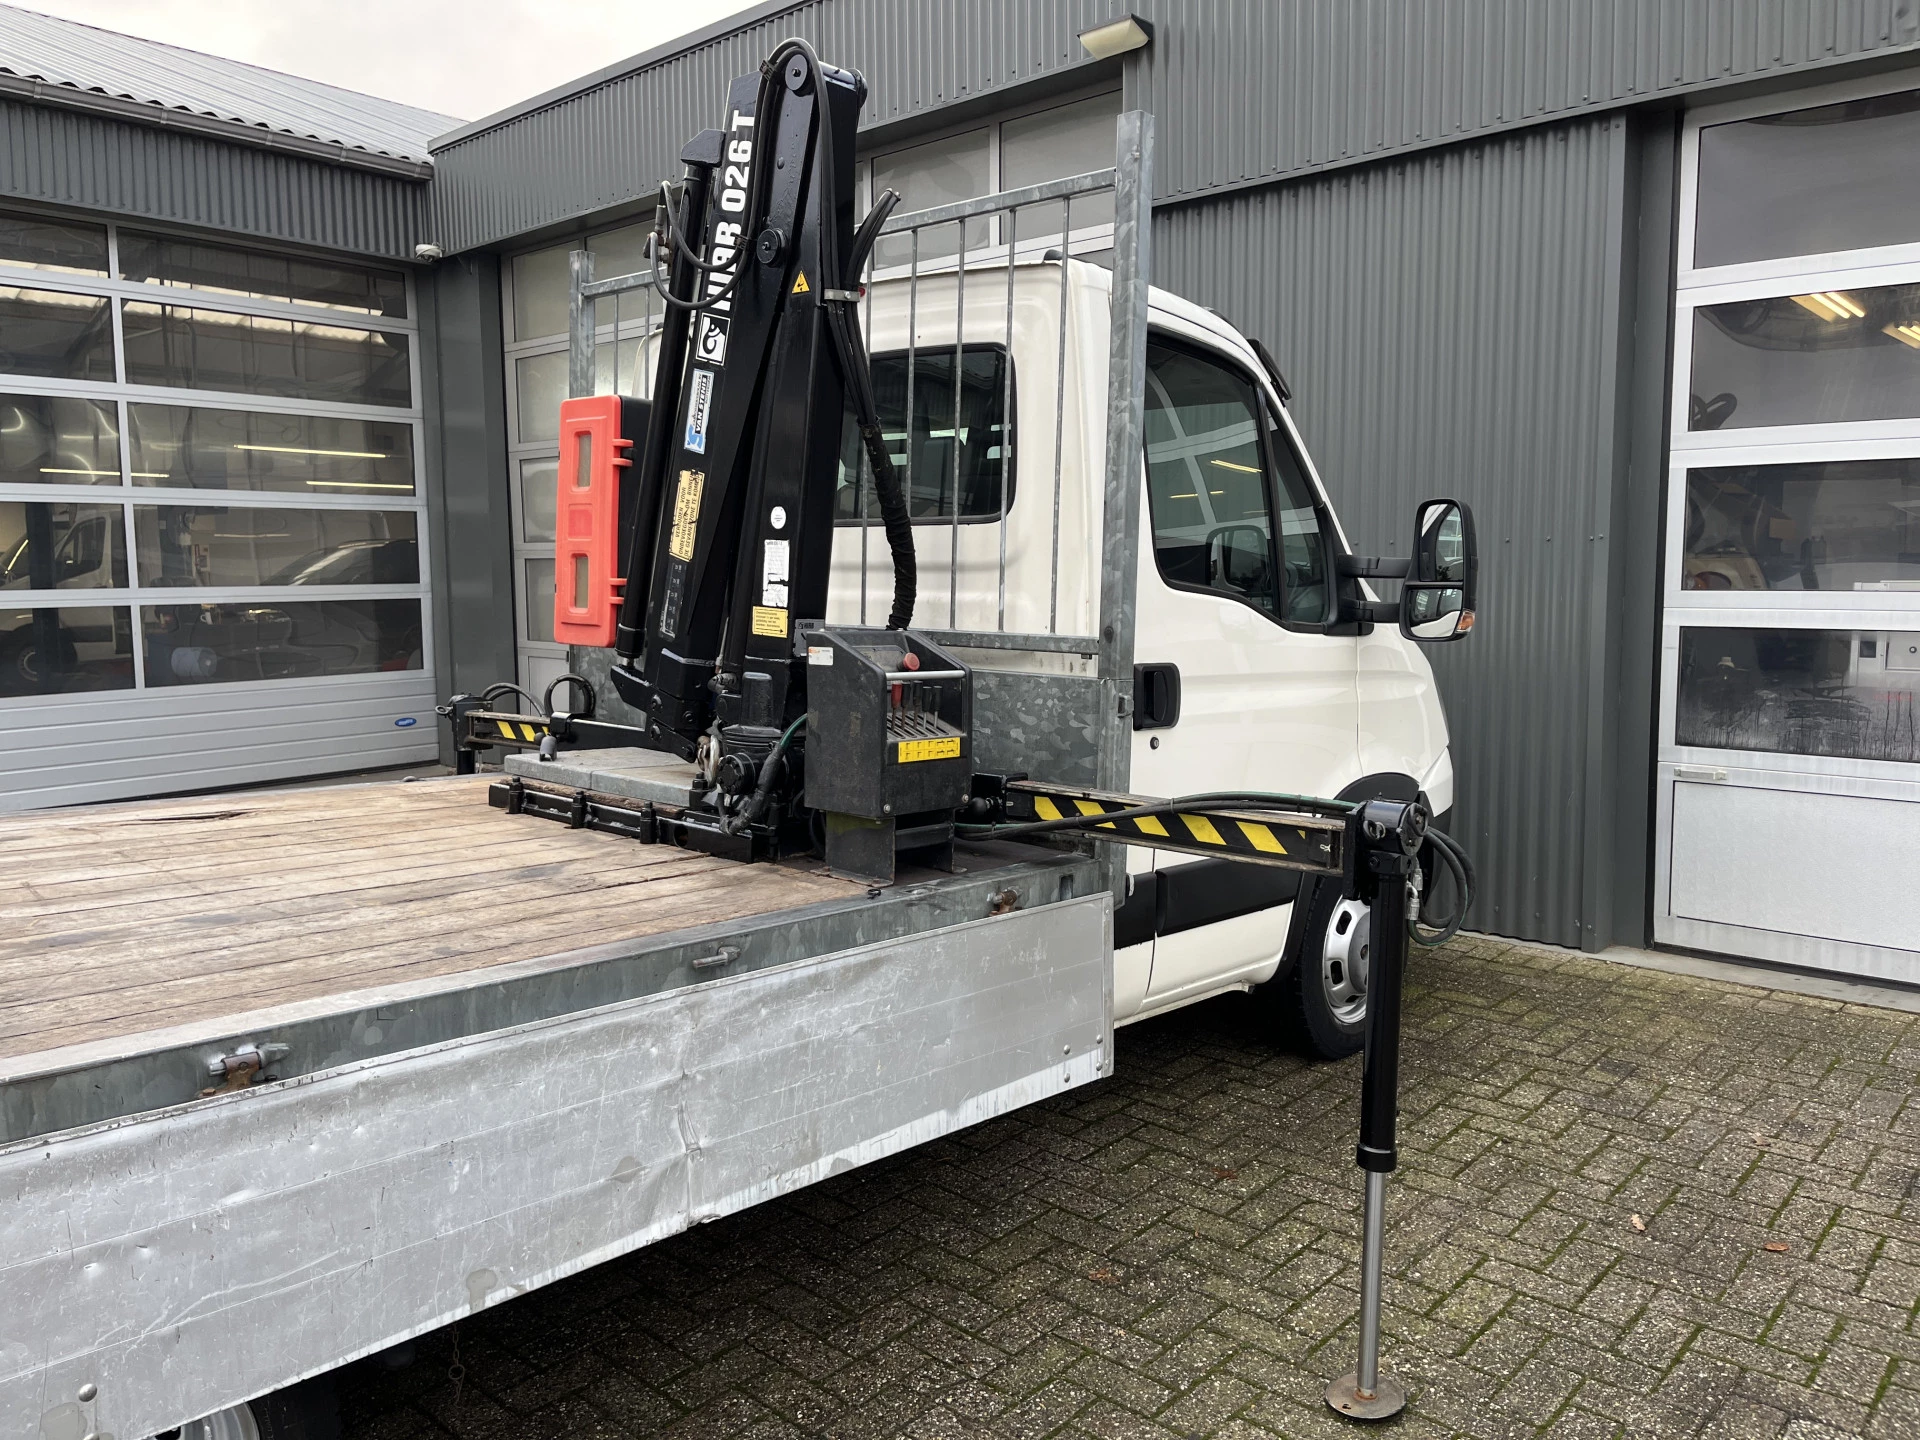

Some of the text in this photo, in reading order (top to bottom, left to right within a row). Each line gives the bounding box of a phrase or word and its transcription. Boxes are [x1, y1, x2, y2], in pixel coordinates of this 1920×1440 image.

[704, 109, 755, 311] HIAB 026 T
[698, 377, 707, 410] STENIS
[695, 411, 703, 431] VAN
